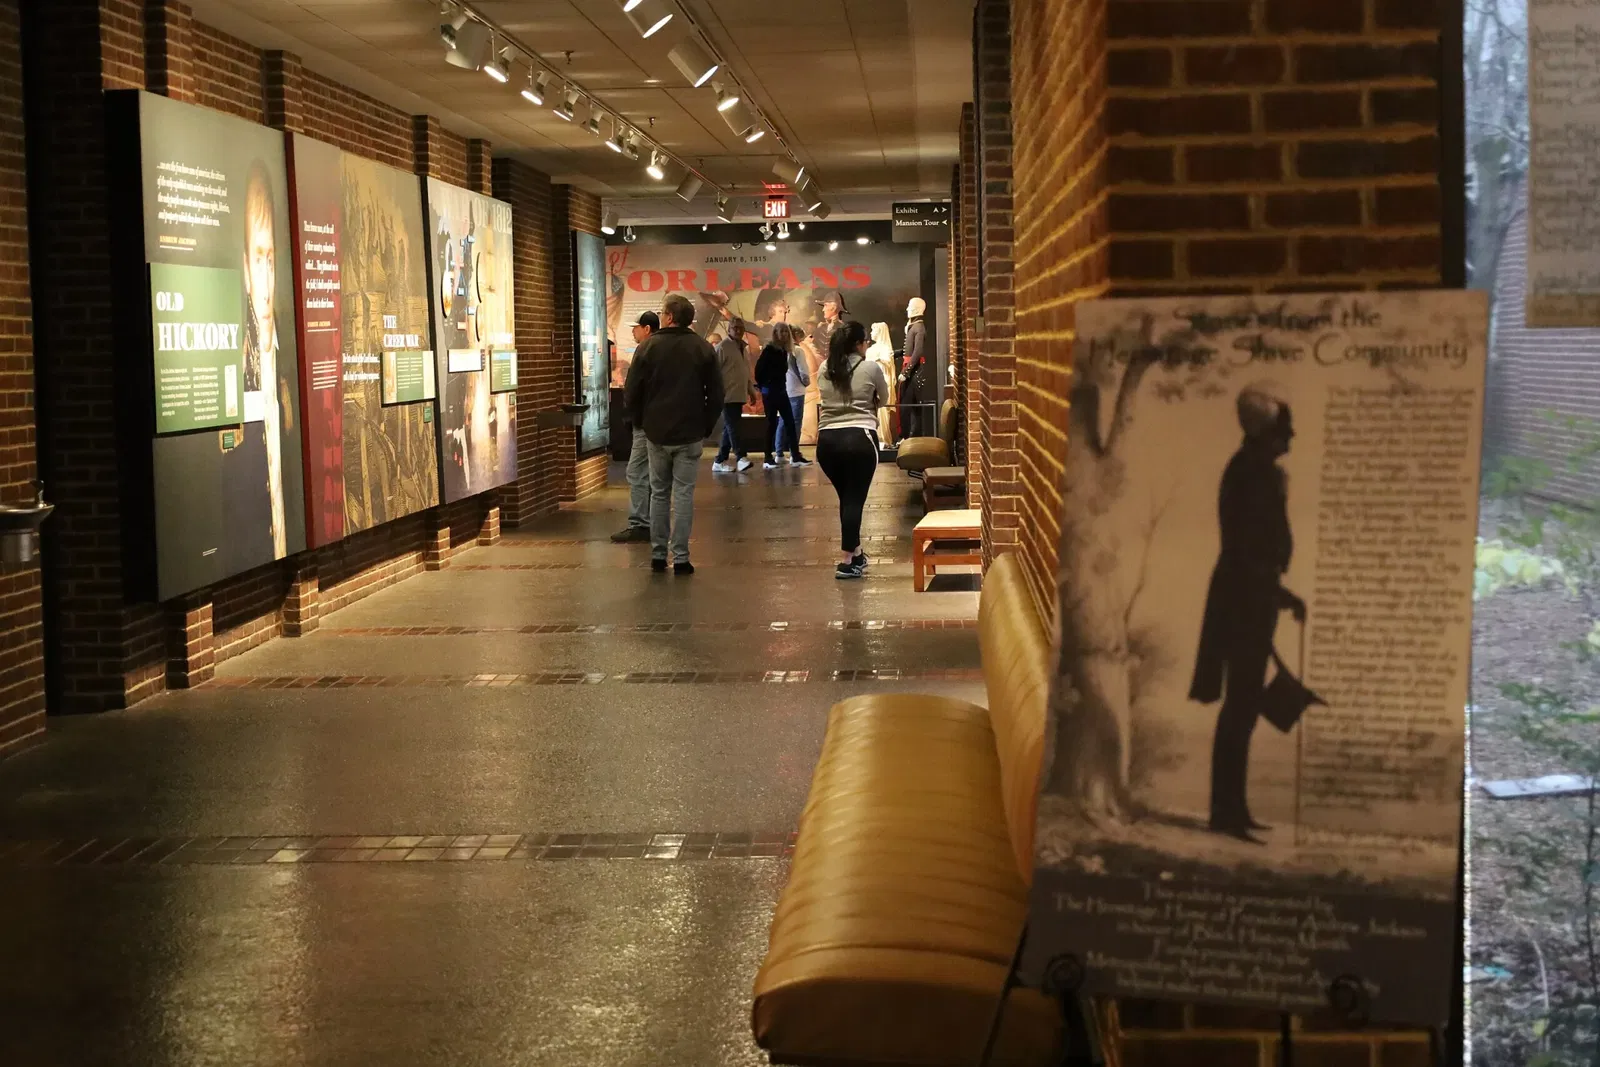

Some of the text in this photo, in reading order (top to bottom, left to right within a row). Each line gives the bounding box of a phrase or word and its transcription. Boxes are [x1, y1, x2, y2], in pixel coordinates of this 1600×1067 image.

[492, 203, 512, 235] 1812
[764, 200, 788, 217] EXIT
[627, 266, 872, 293] ORLEANS
[156, 291, 184, 311] OLD
[1340, 299, 1382, 327] the
[383, 314, 397, 328] THE
[157, 322, 239, 351] HICKORY
[1313, 332, 1468, 370] Community
